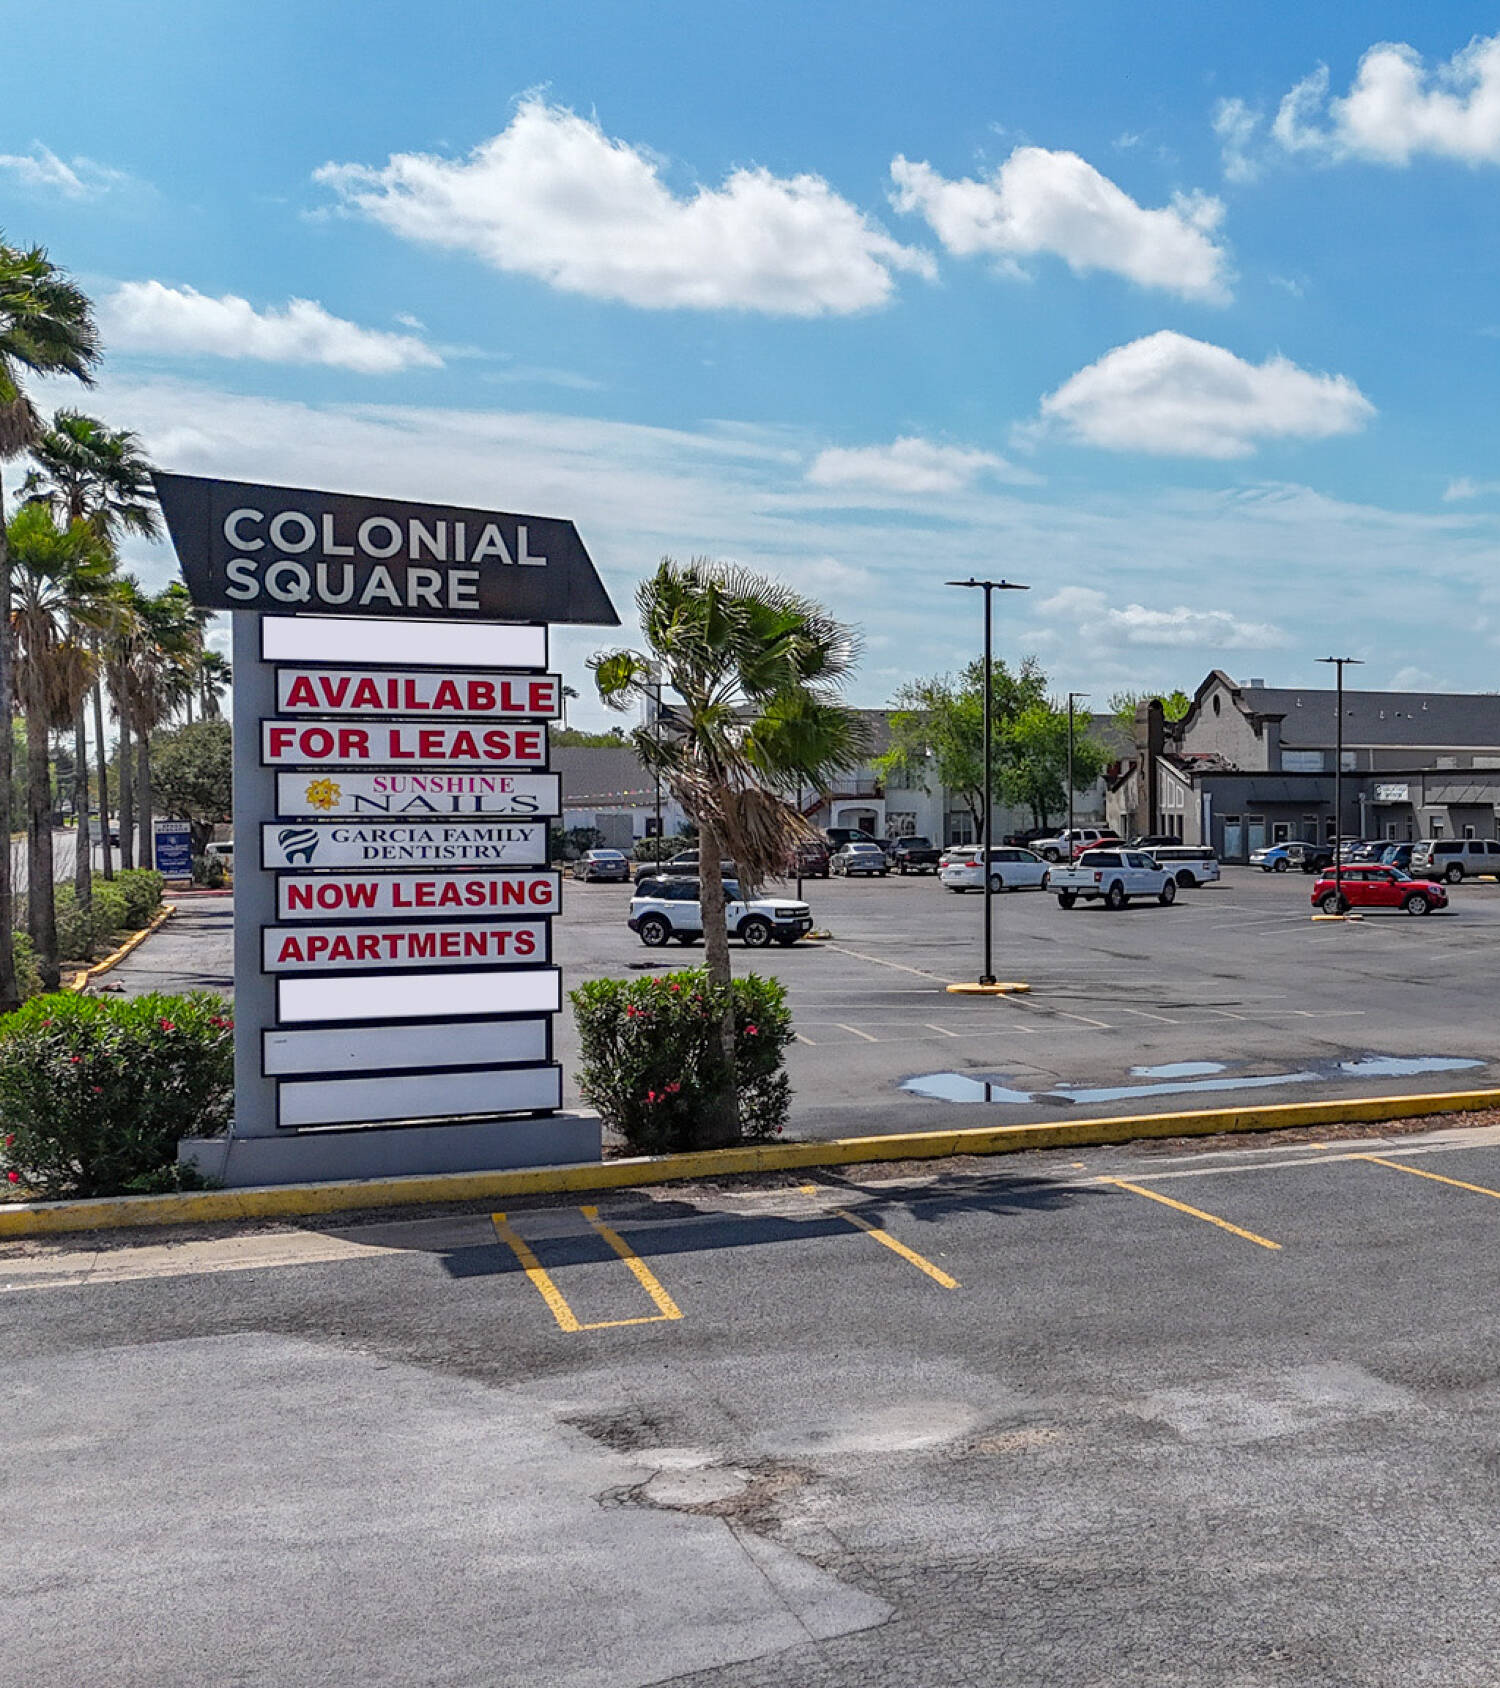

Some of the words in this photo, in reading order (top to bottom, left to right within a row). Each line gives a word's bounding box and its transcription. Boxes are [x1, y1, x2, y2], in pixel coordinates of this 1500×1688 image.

[223, 508, 548, 567] COLONIAL
[225, 558, 481, 610] SQUARE
[286, 676, 555, 713] AVAILABLE
[269, 728, 370, 759] FOR
[389, 729, 541, 760] LEASE
[372, 775, 515, 794] SUNSHINE
[349, 794, 540, 814] NAILS
[330, 828, 435, 844] GARCIA
[443, 828, 535, 843] FAMILY
[362, 844, 507, 860] DENTISTRY
[287, 883, 379, 911] NOW
[391, 880, 553, 909] LEASING
[277, 930, 536, 963] APARTMENTS
